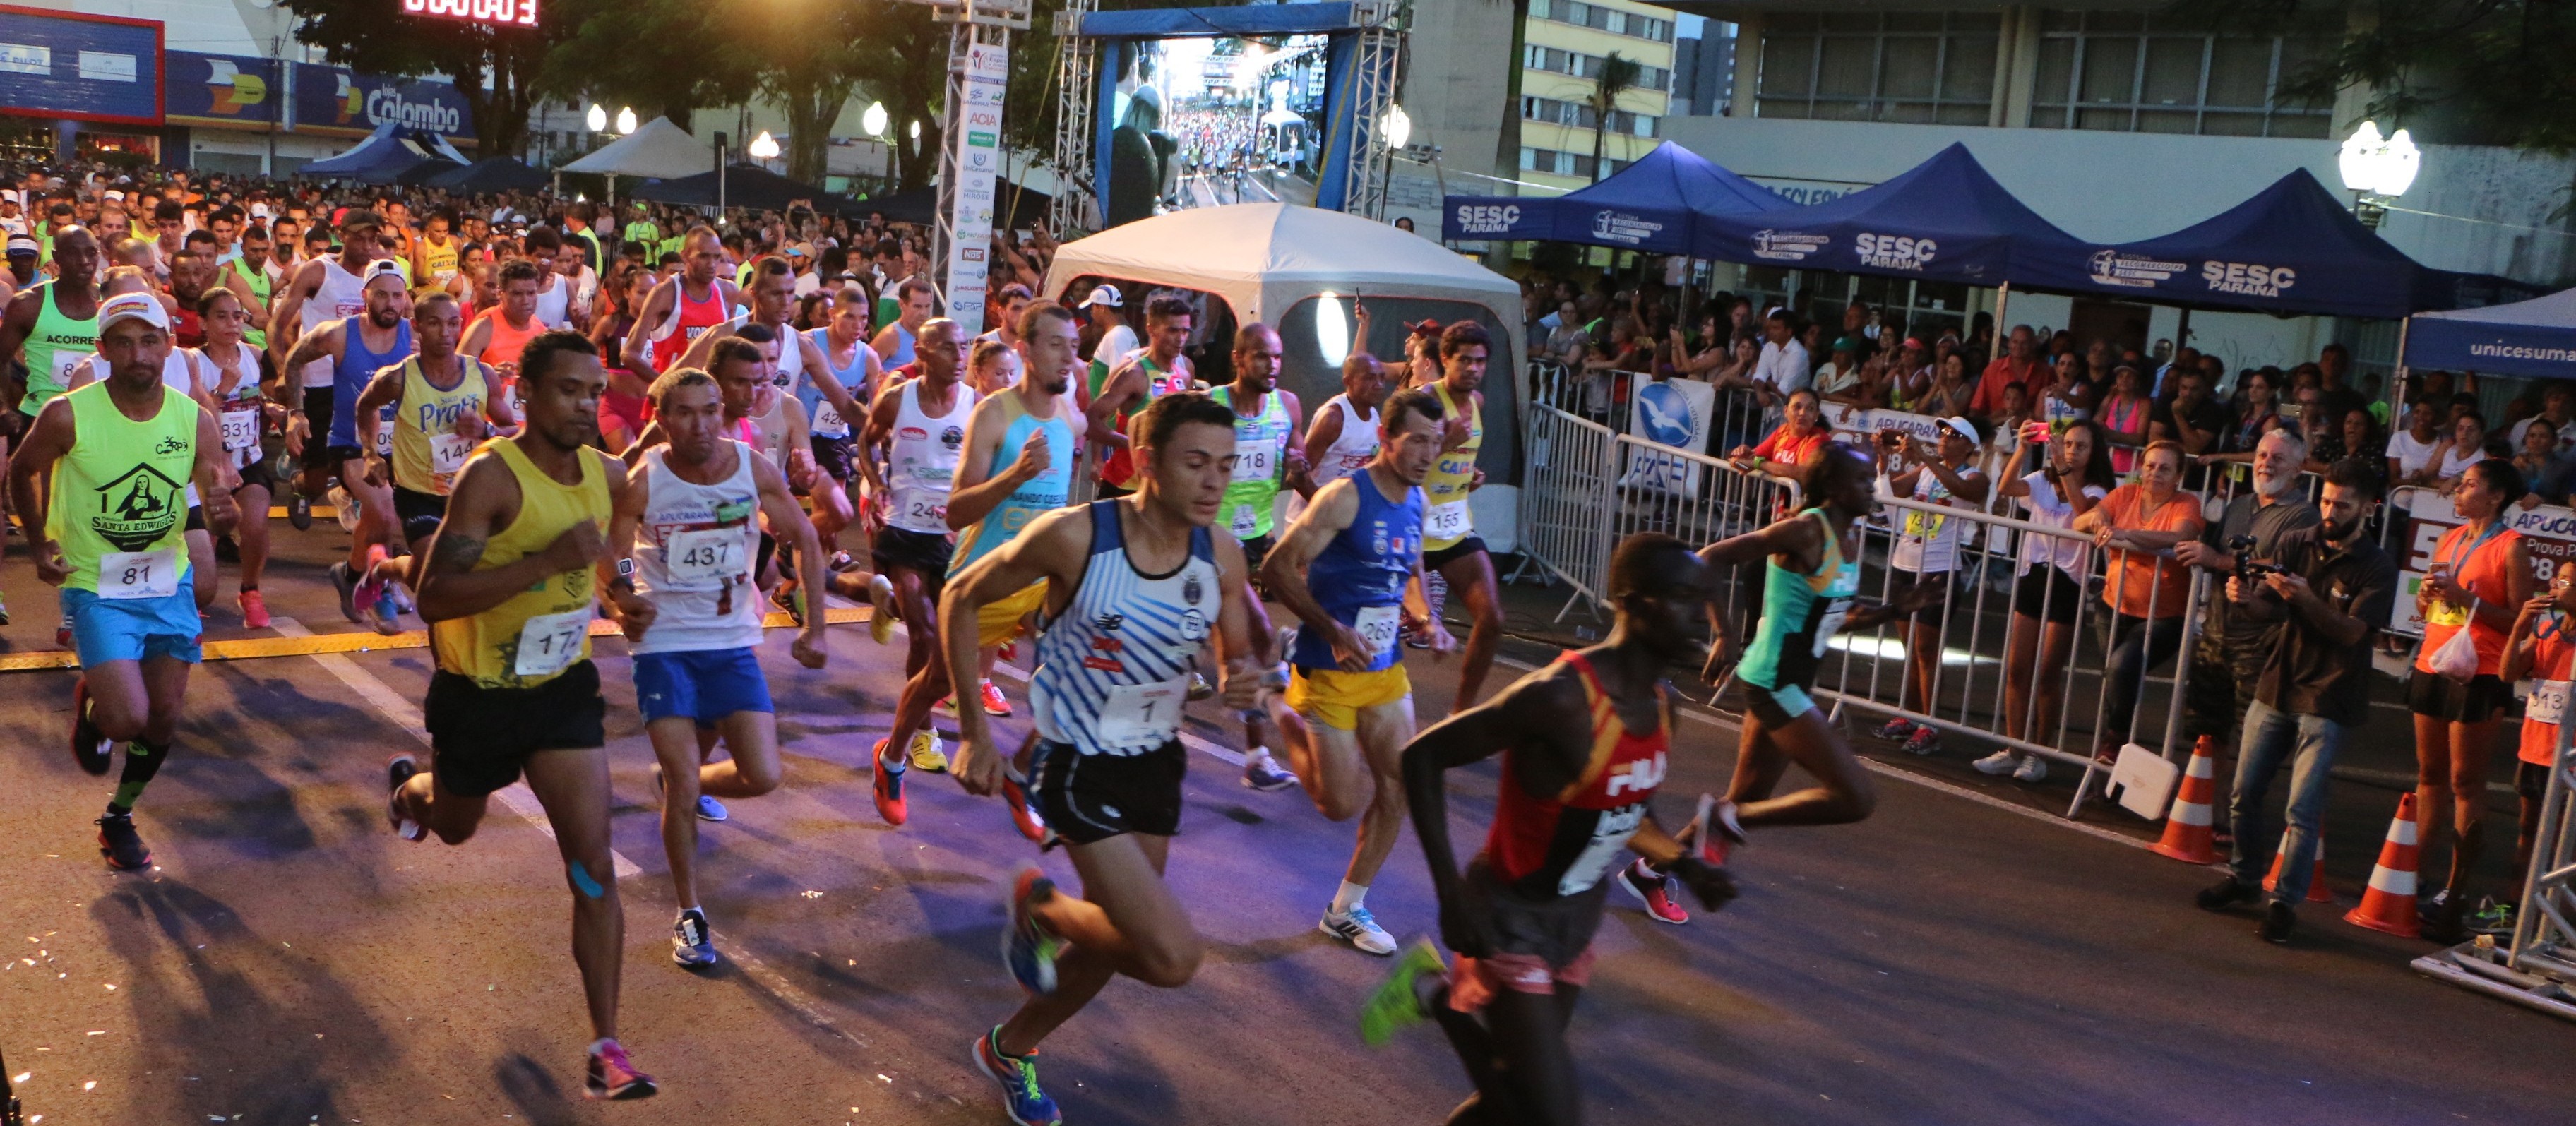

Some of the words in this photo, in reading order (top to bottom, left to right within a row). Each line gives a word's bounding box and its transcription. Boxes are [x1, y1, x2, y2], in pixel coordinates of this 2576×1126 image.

[381, 83, 397, 97] lojas
[367, 90, 459, 133] Colombo
[970, 112, 996, 126] ACIA
[1457, 205, 1520, 224] SESC
[1855, 233, 1937, 262] SESC
[2202, 260, 2296, 288] SESC
[221, 422, 250, 438] 831
[440, 440, 474, 462] 144
[92, 516, 130, 532] SANTA
[134, 510, 177, 532] EDWIGES
[683, 541, 729, 567] 437
[2527, 537, 2564, 556] Prova
[122, 565, 150, 585] 81
[1141, 700, 1156, 723] 1
